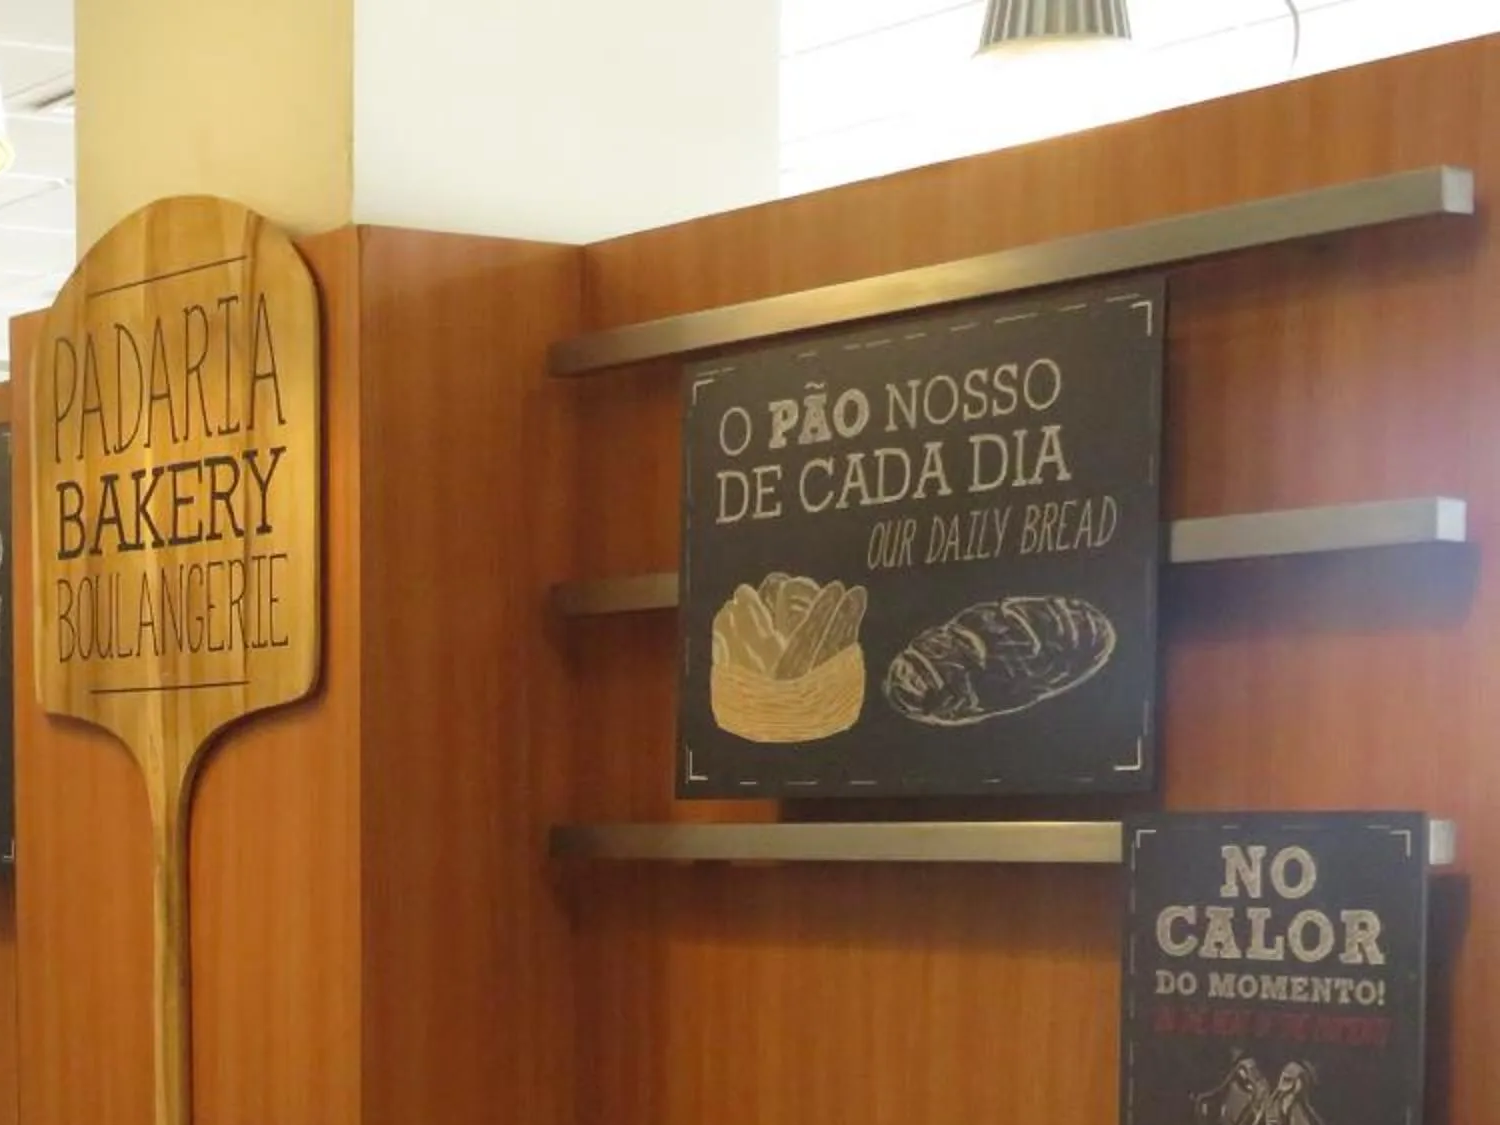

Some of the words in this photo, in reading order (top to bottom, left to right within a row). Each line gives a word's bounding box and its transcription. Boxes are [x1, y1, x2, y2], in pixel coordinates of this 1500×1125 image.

[53, 293, 287, 464] PADARIA
[719, 406, 752, 457] O
[768, 381, 870, 450] PÃO
[884, 358, 1062, 434] NOSSO
[55, 446, 288, 562] BAKERY
[715, 464, 783, 525] DE
[799, 440, 954, 513] CADA
[967, 424, 1073, 494] DIA
[866, 516, 918, 571] OUR
[924, 504, 1013, 565] DAILY
[1019, 494, 1118, 556] BREAD
[56, 552, 290, 664] BOULANGERIE
[1219, 844, 1318, 900] NO
[1155, 904, 1386, 966] CALOR
[1155, 970, 1196, 997] DO
[1208, 971, 1387, 1007] MOMENTO!
